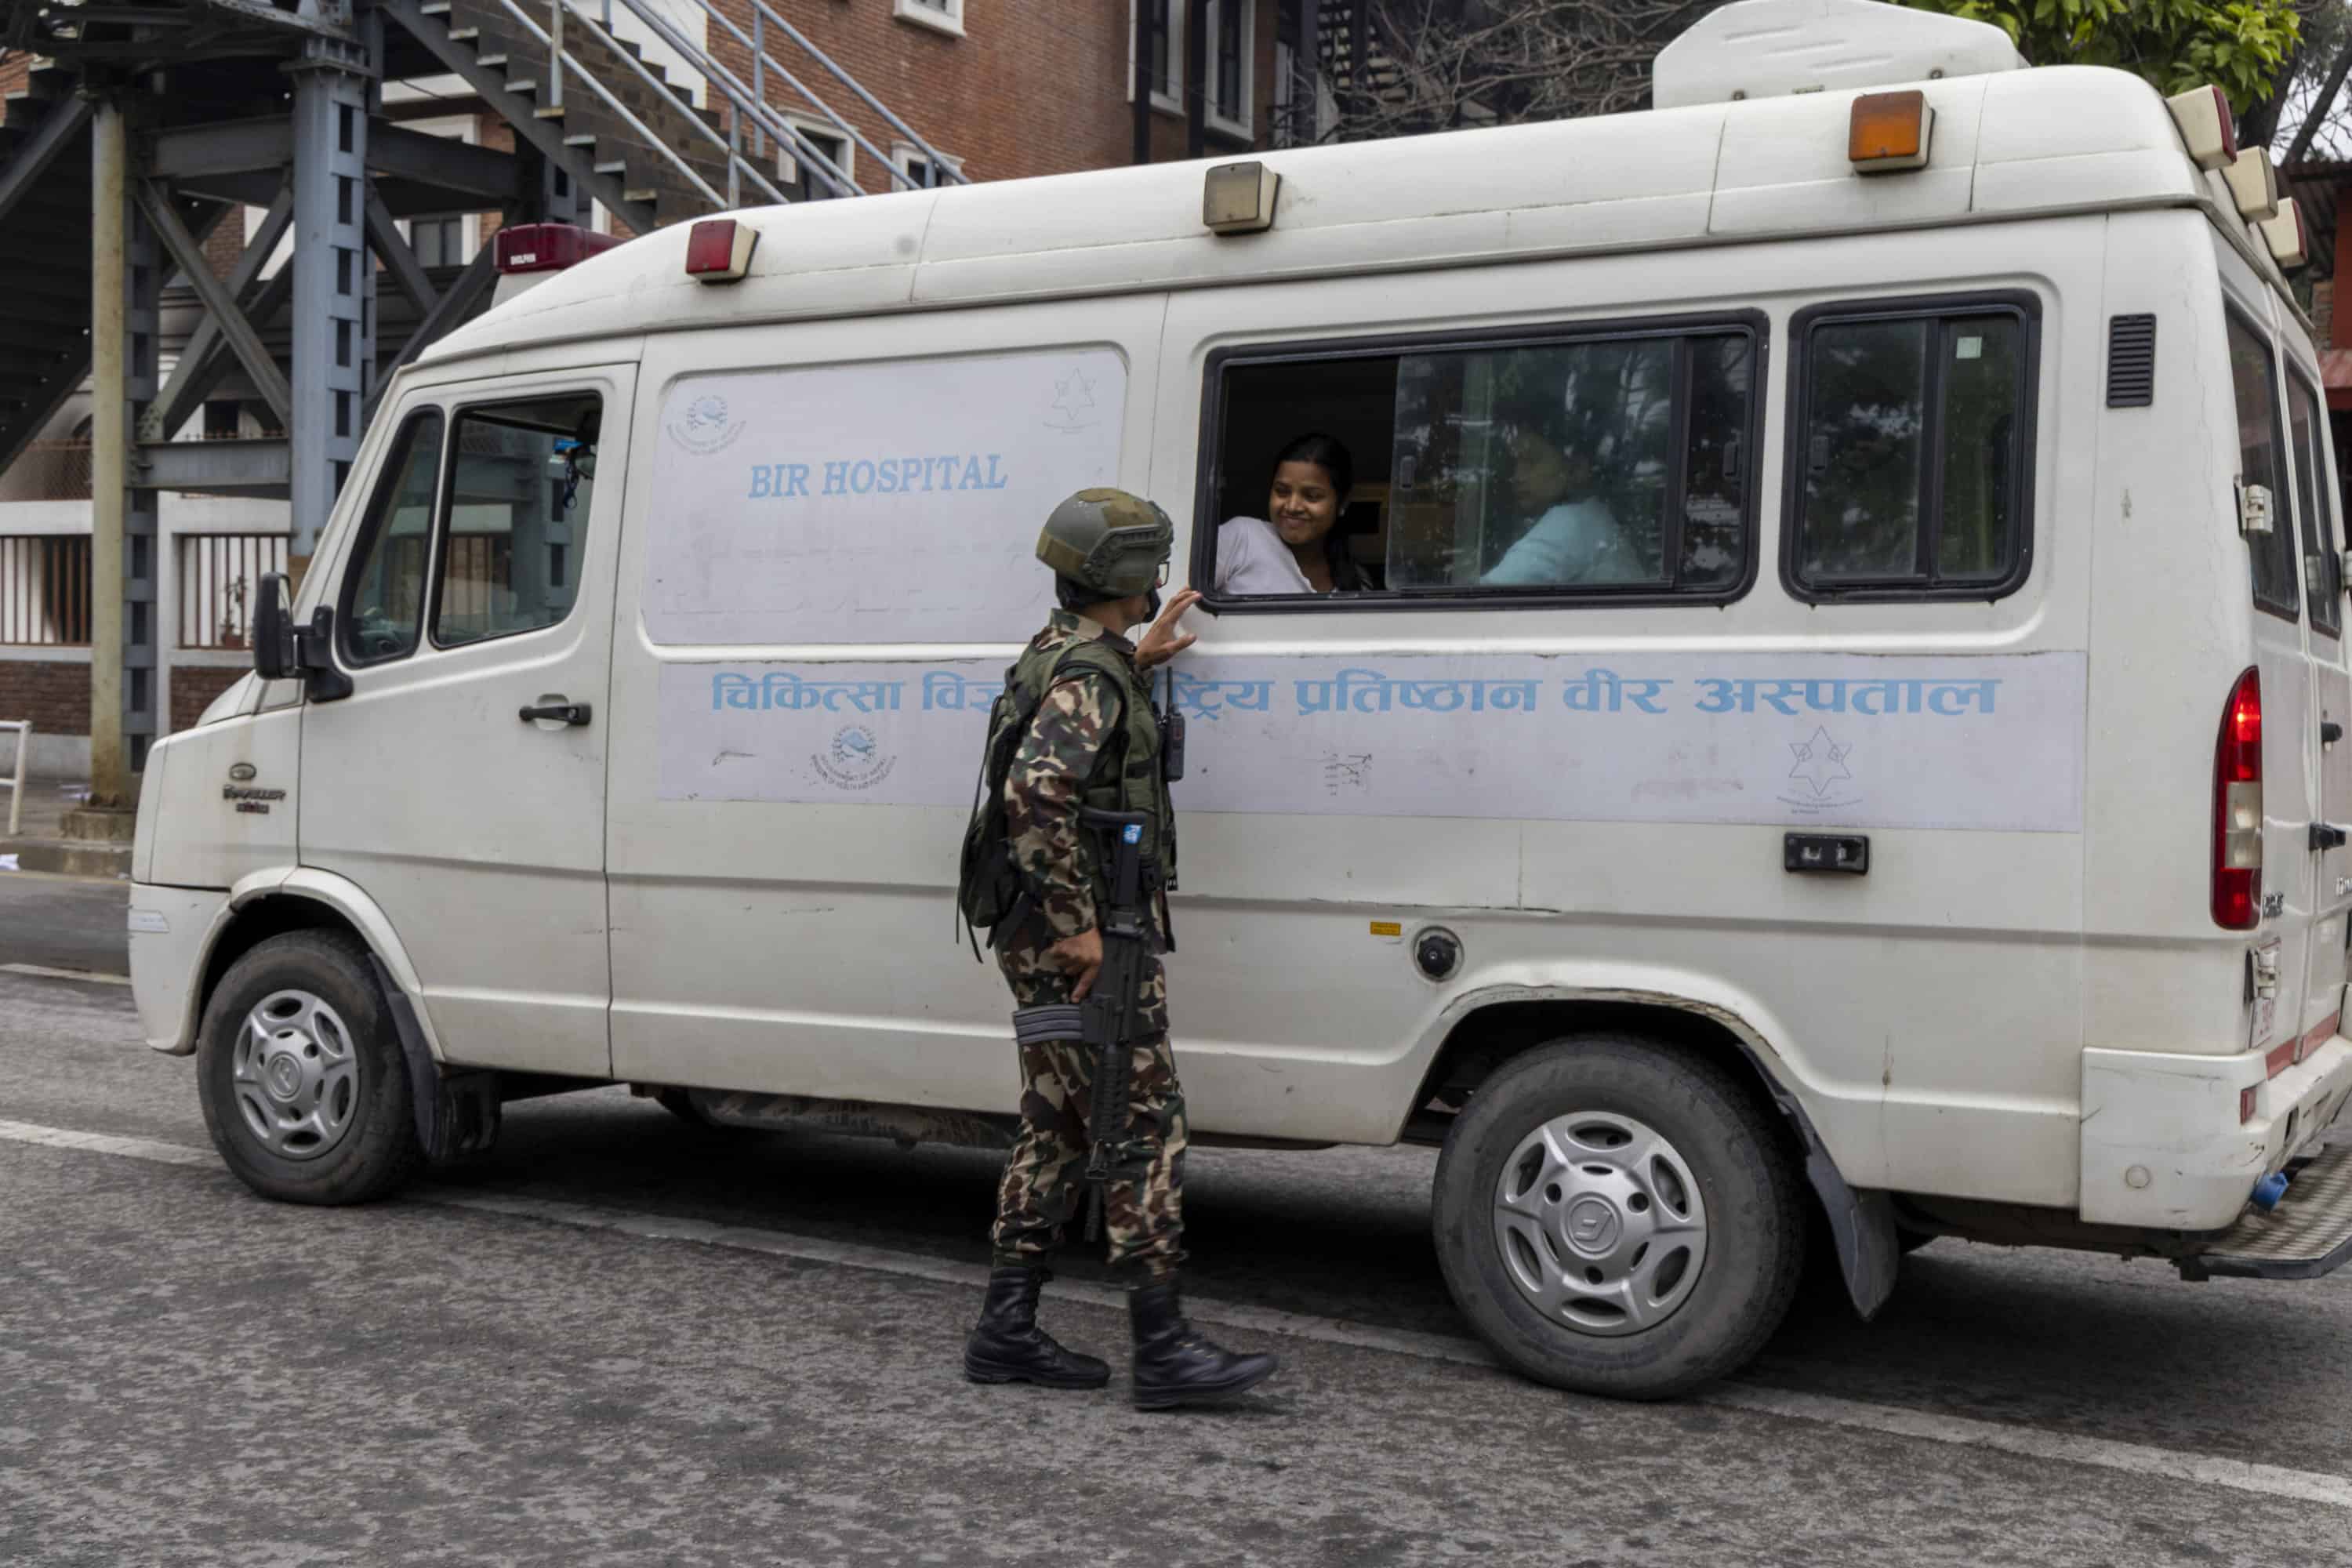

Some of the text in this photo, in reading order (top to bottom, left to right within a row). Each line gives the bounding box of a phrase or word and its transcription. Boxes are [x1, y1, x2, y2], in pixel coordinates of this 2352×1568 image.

[748, 454, 1008, 498] BIR HOSPITAL
[711, 672, 907, 713] चिकित्सा
[1293, 668, 1544, 716] प्रतिष्ठान
[1563, 669, 1675, 713] वीर
[1693, 679, 2003, 715] अस्पताल
